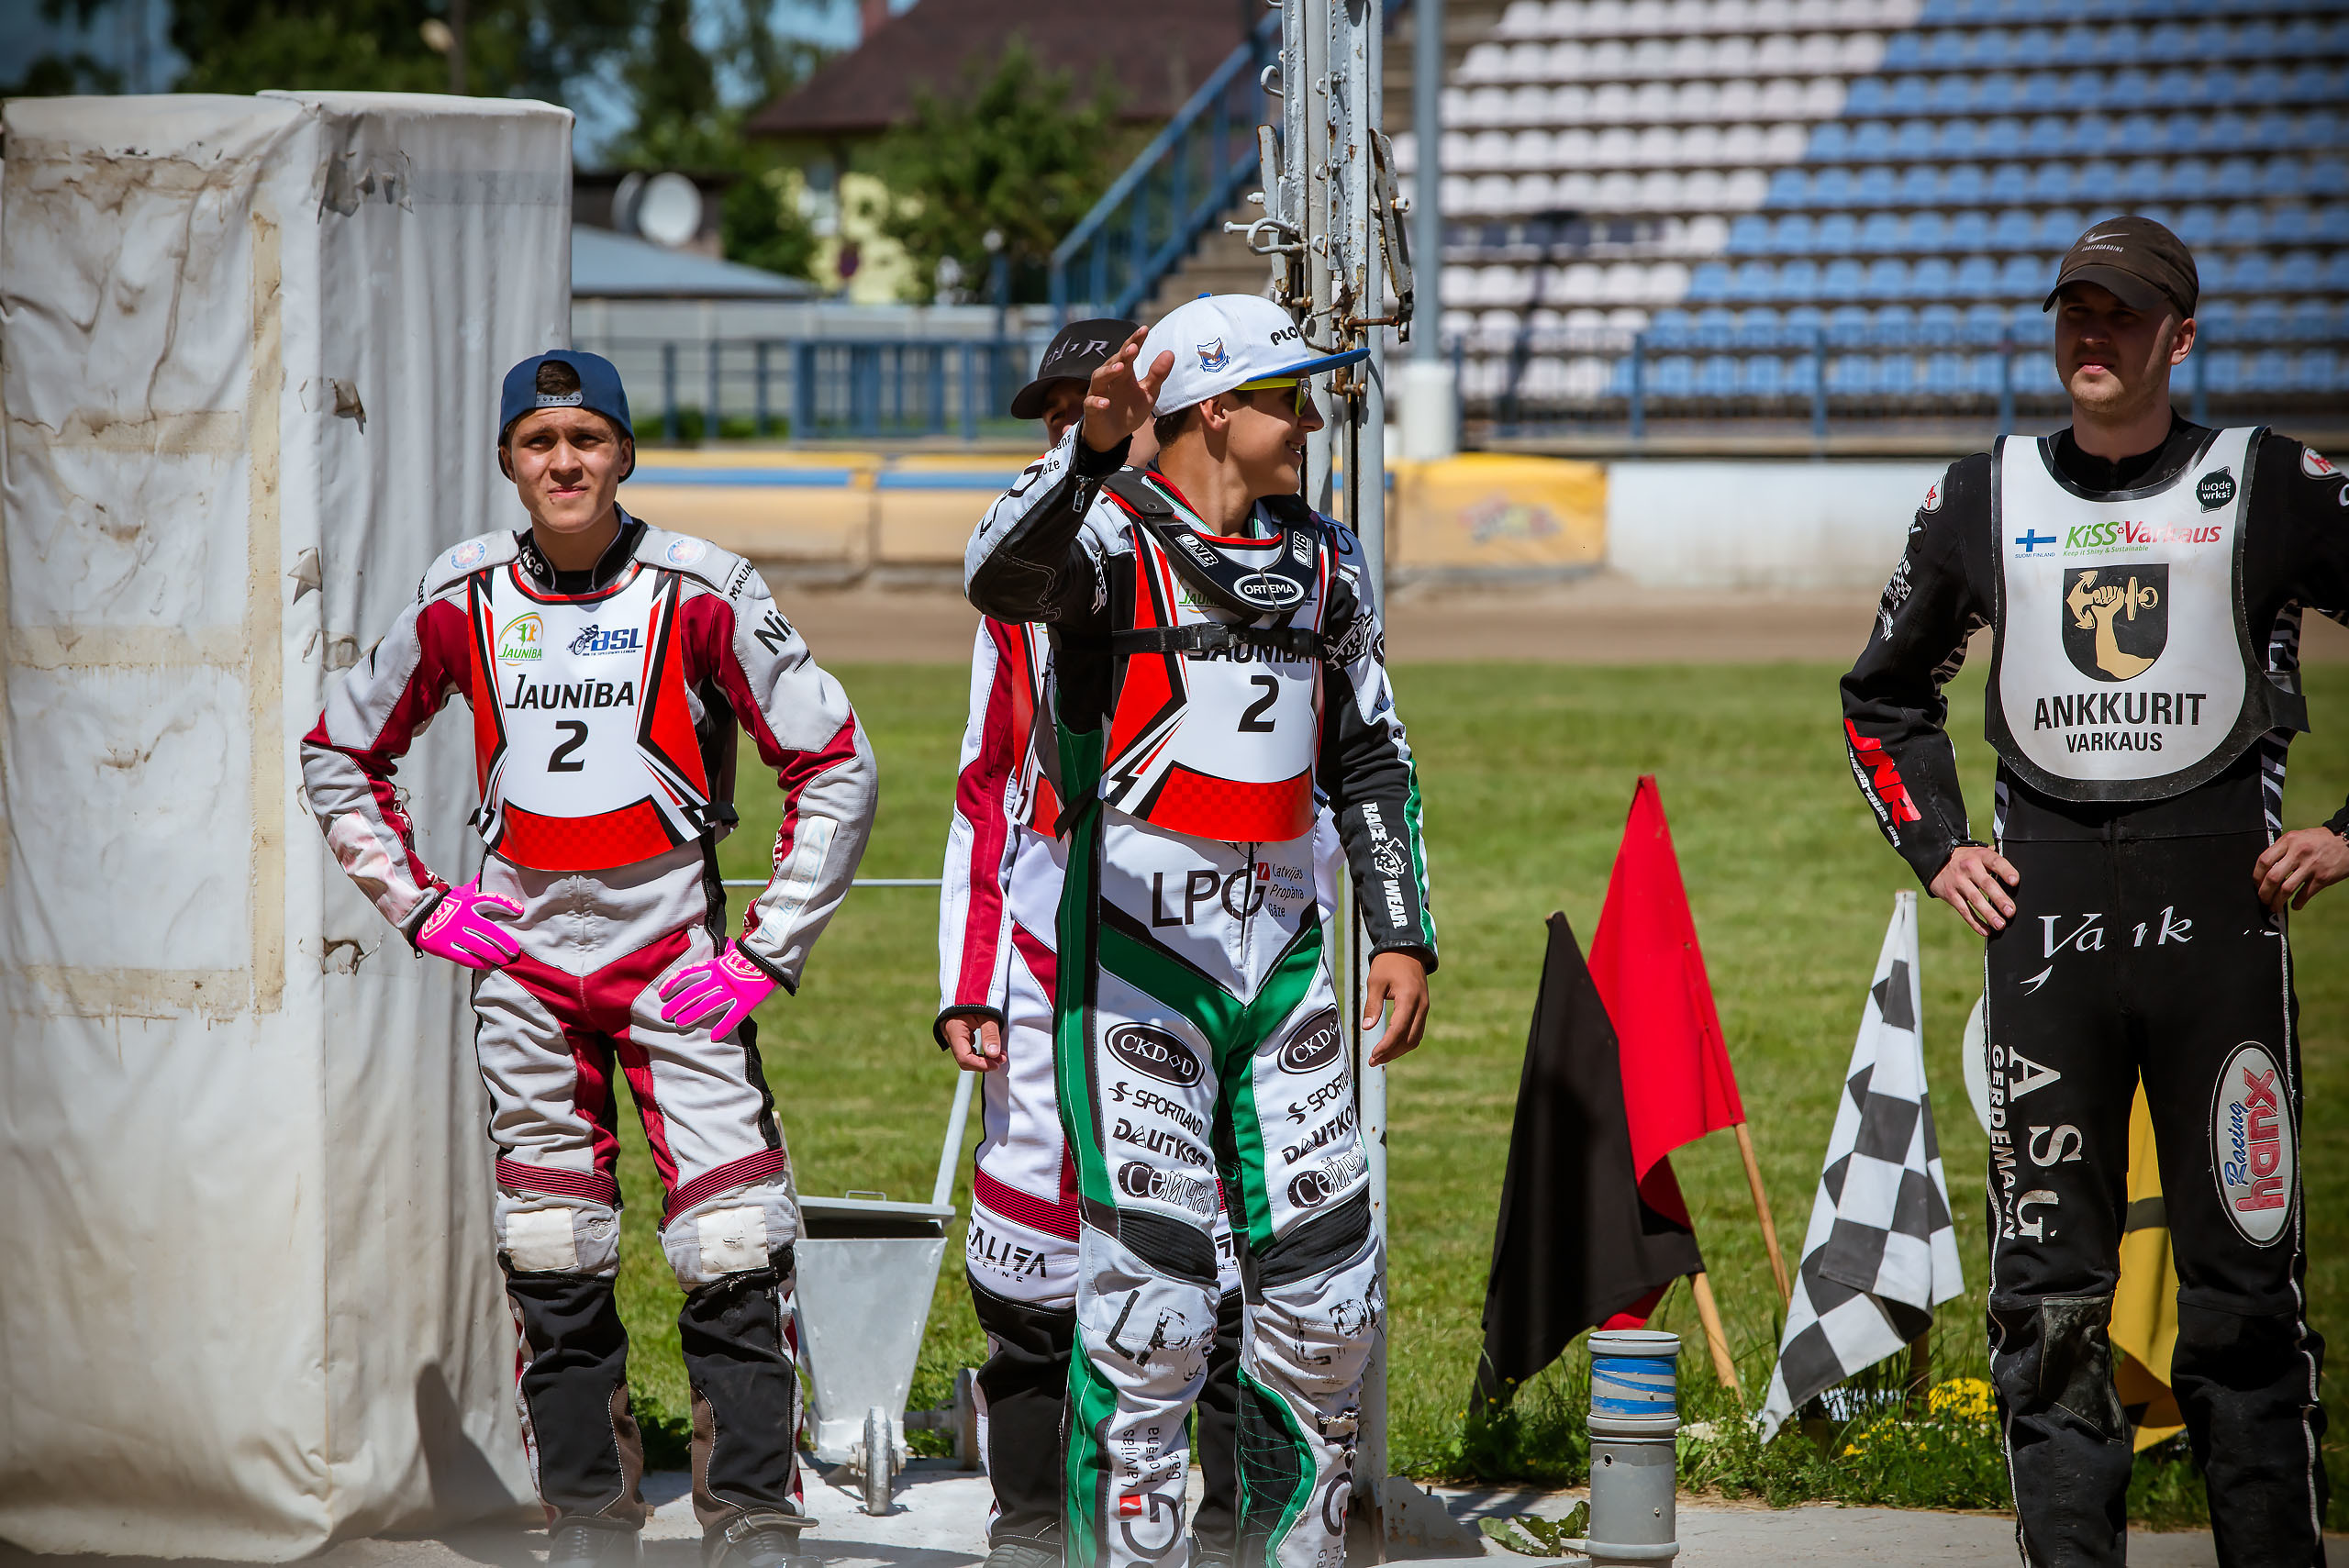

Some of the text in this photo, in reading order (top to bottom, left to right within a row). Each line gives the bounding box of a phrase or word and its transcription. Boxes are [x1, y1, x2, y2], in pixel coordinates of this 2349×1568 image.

[2065, 521, 2222, 550] KiSS Varkaus
[2087, 549, 2104, 557] Shiny
[1243, 584, 1295, 595] ORTEMA
[591, 628, 643, 651] BSL
[505, 674, 635, 709] JAUNĪBA
[1237, 675, 1280, 733] 2
[2033, 692, 2207, 731] ANKKURIT
[547, 720, 589, 773] 2
[2065, 732, 2163, 753] VARKAUS
[1362, 801, 1388, 841] RACE
[1272, 863, 1304, 881] Latvijas
[1383, 879, 1408, 929] WEAR
[1132, 1089, 1203, 1138] SPORTLAND
[1281, 1105, 1355, 1166] DAUTKO
[1991, 1044, 2017, 1240] GERDEMANN
[2224, 1100, 2250, 1187] Racing
[1121, 1429, 1141, 1488] Latvijas
